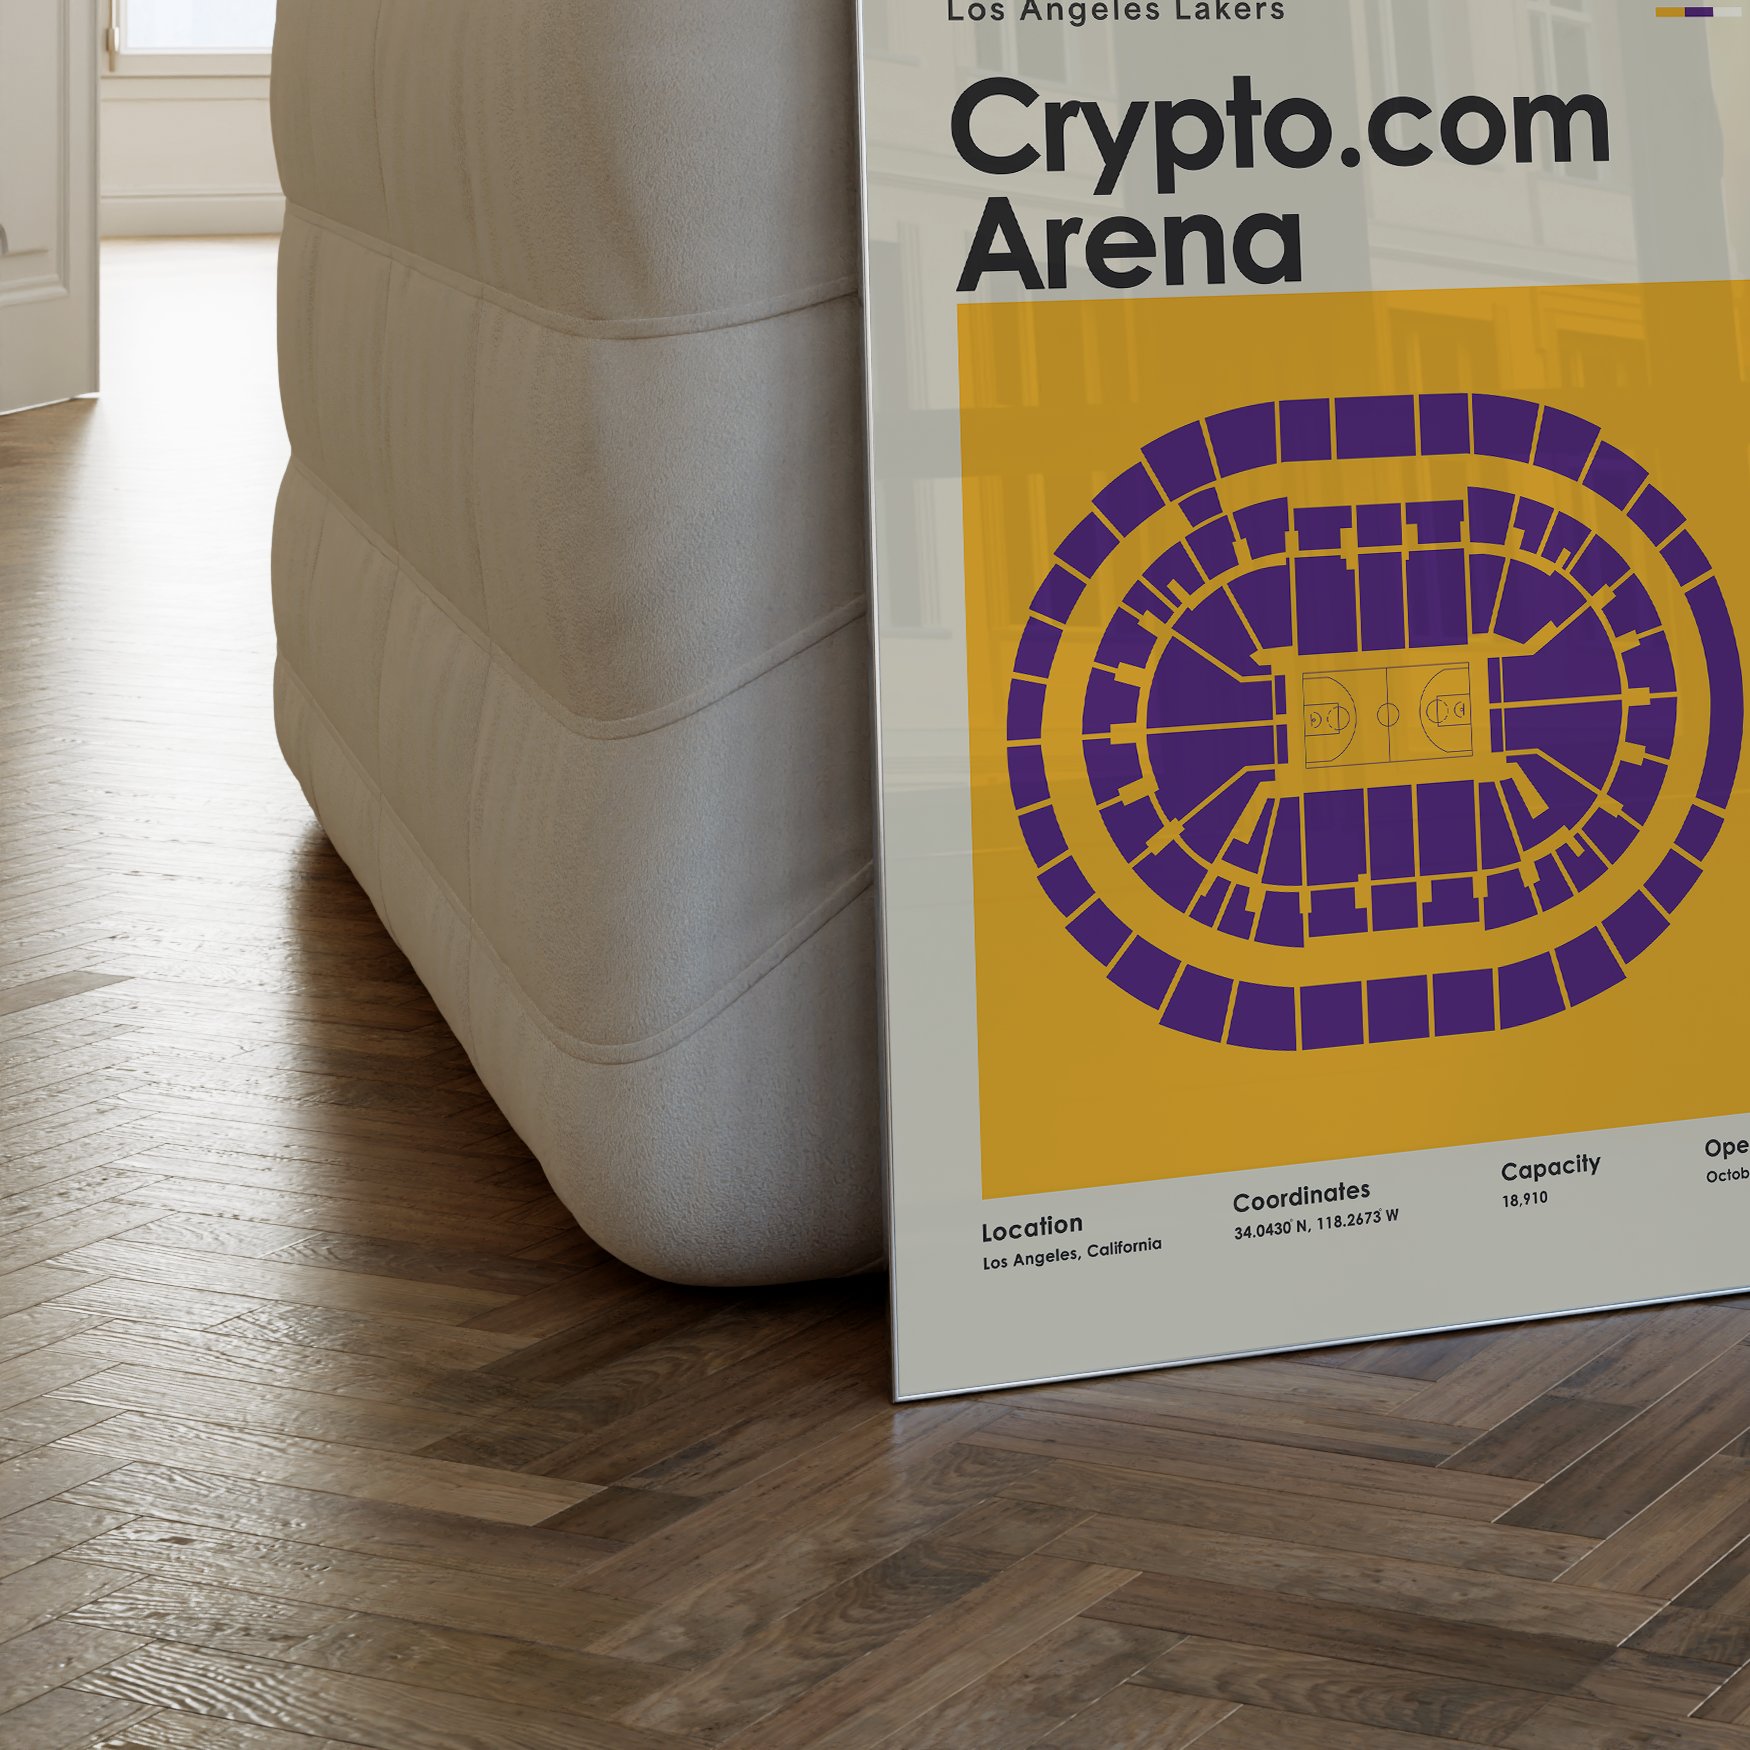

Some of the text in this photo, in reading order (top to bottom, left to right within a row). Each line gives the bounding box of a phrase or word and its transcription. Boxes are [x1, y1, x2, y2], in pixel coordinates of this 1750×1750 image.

[951, 76, 1609, 195] Crypto.com
[956, 196, 1301, 291] Arena
[1502, 1154, 1601, 1182] Capacity
[1234, 1182, 1372, 1215] Coordinates
[1503, 1191, 1547, 1207] 18,910
[983, 1216, 1082, 1242] Location
[1297, 1220, 1311, 1233] N,
[1386, 1209, 1398, 1221] W
[984, 1237, 1161, 1270] Los Angeles, California
